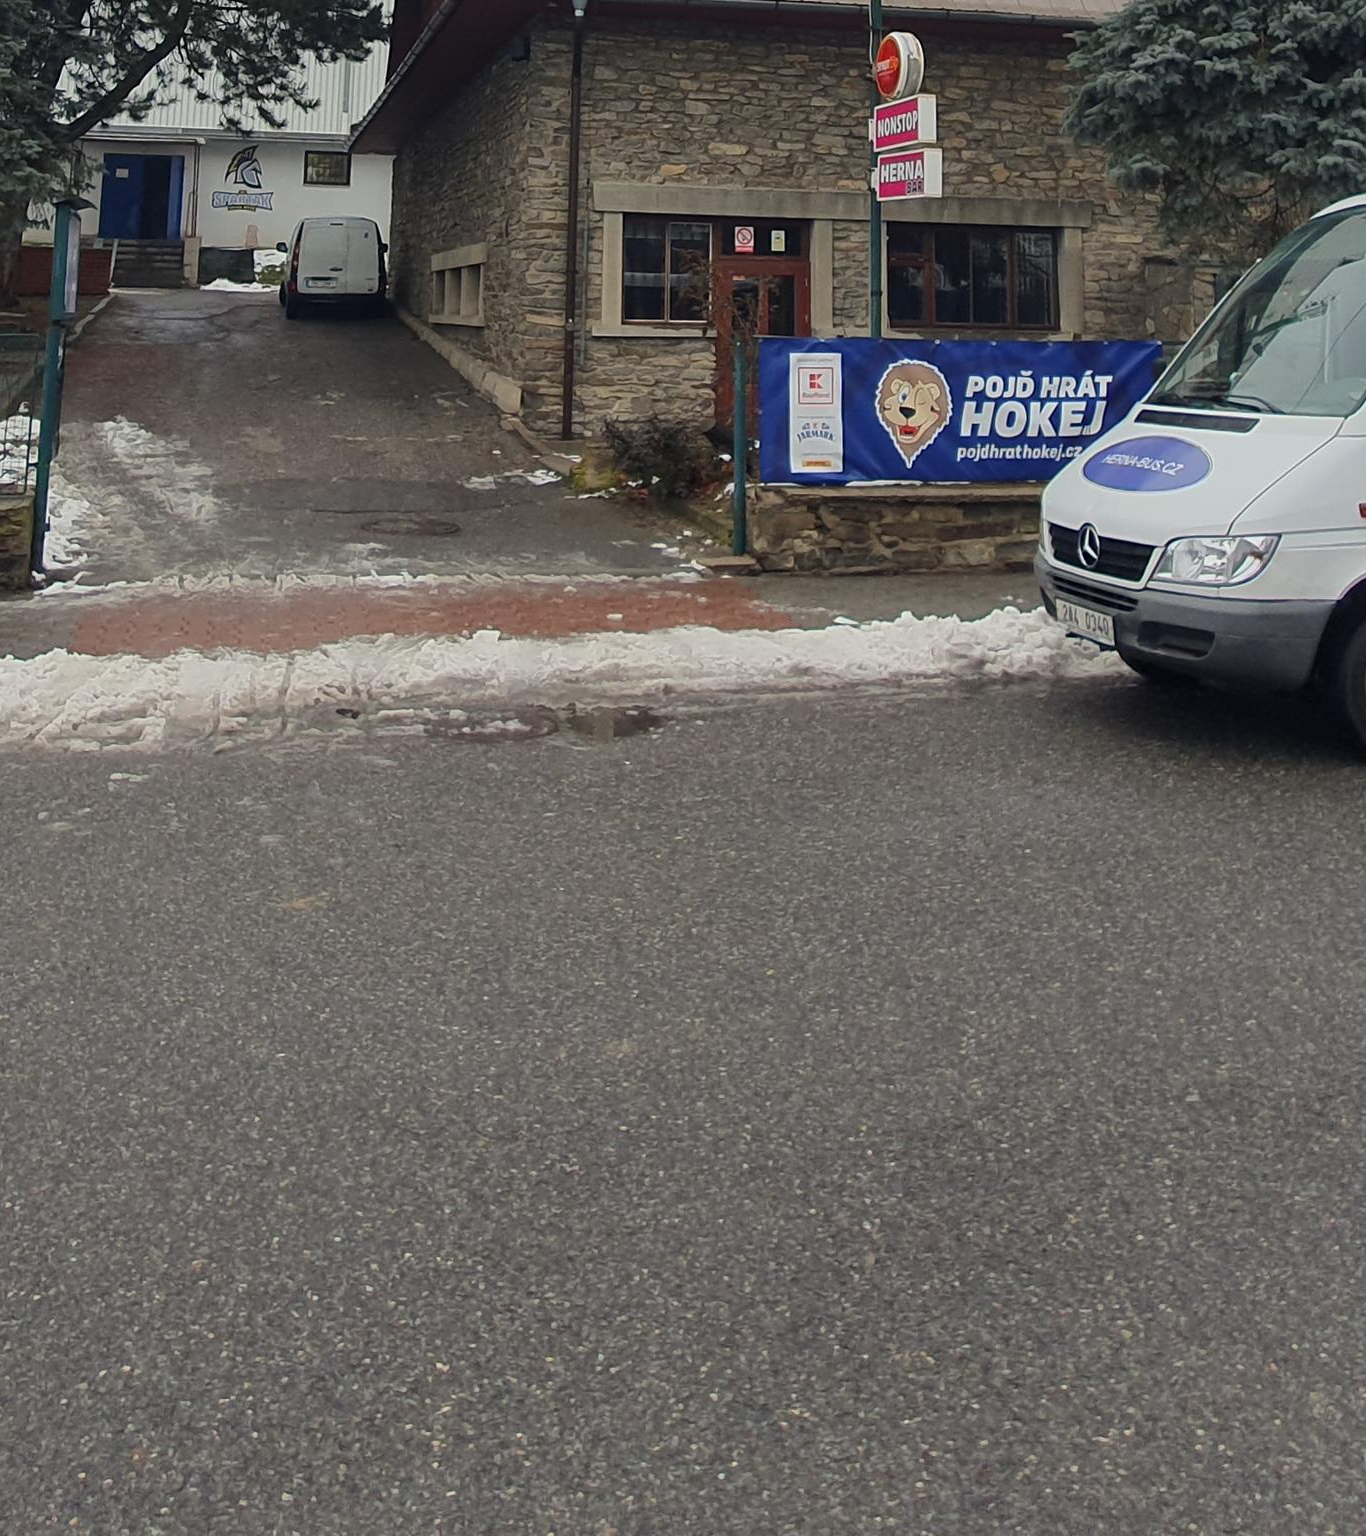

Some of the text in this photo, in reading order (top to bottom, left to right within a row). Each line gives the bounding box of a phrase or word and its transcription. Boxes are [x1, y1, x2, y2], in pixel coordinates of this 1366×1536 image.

[877, 111, 918, 138] NONSTOP
[881, 160, 924, 183] HERNA
[906, 179, 923, 194] BAR
[965, 370, 1113, 398] POJĎ HRÁT
[960, 400, 1107, 438] HOKEJ
[957, 444, 1083, 462] pojdhrathokej.cz
